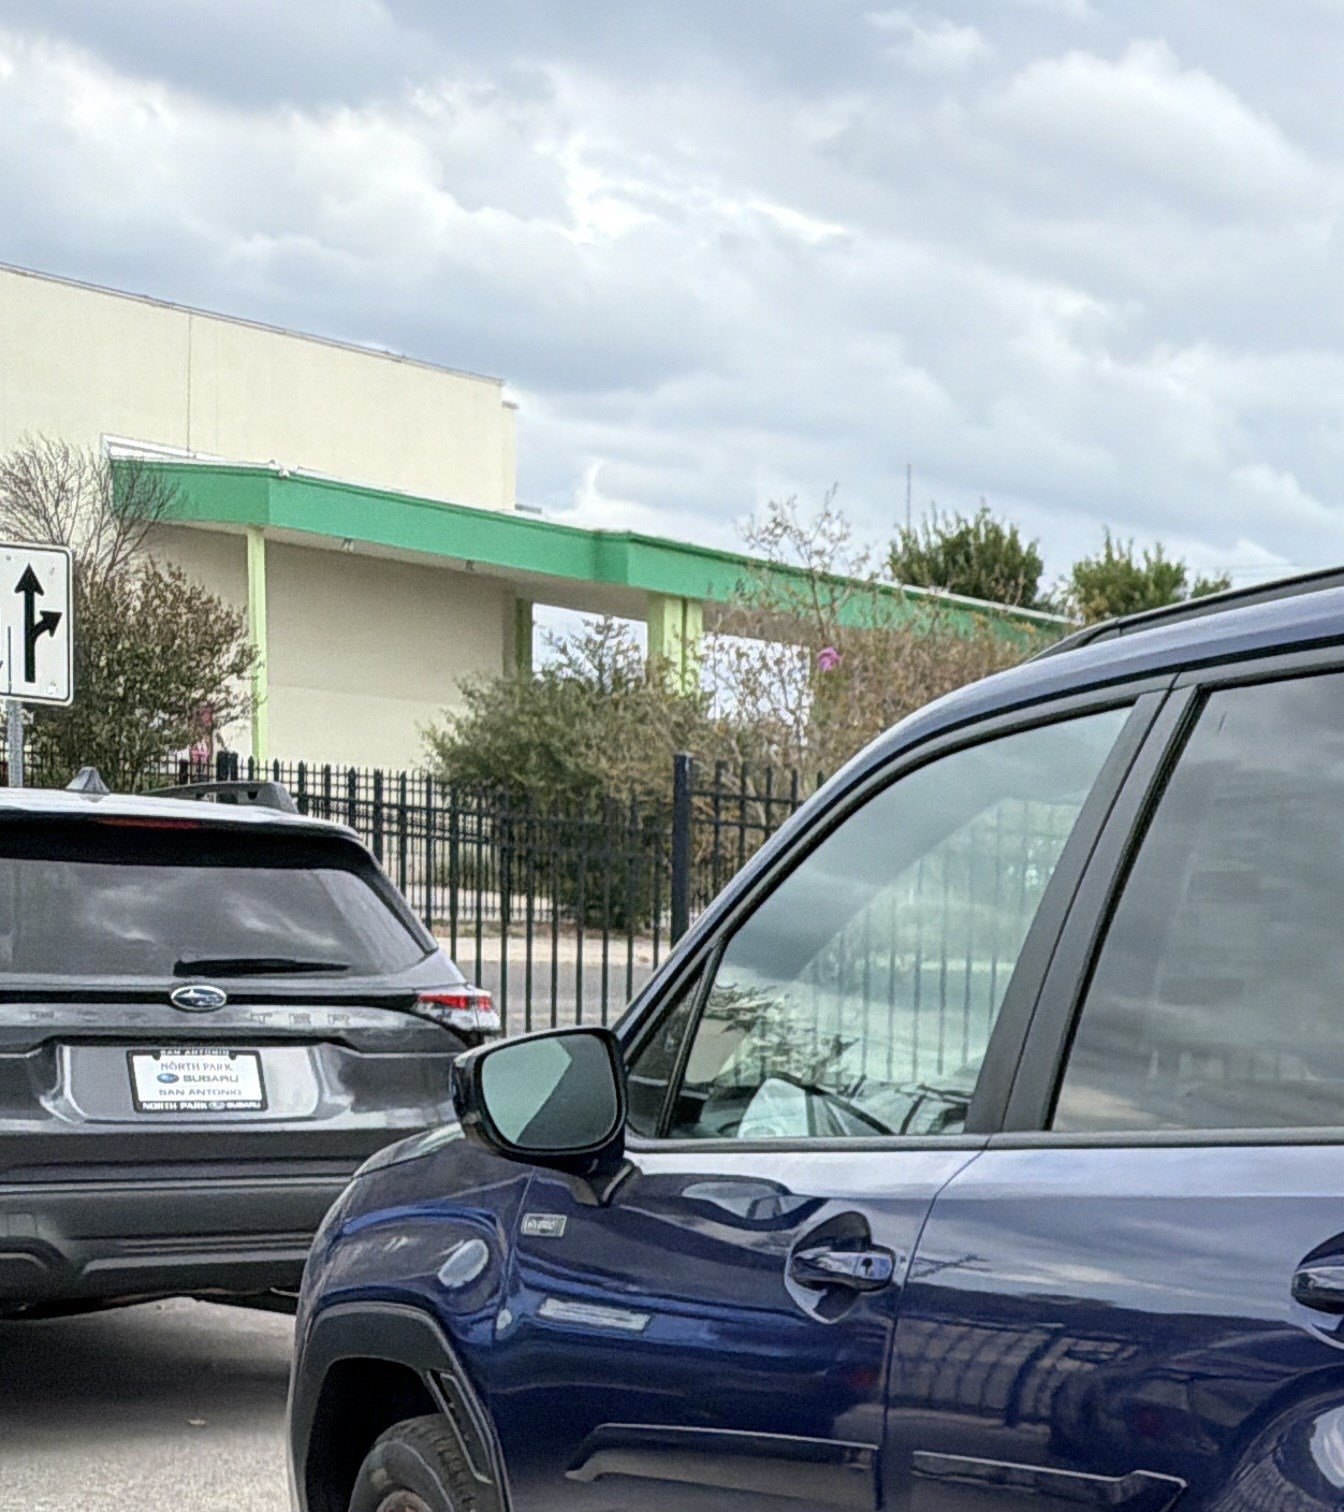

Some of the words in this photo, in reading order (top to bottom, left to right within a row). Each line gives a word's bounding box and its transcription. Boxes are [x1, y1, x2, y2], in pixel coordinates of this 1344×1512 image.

[160, 1061, 200, 1071] NORTH
[203, 1062, 233, 1071] PARK
[183, 1074, 239, 1083] SUBARU
[142, 1102, 177, 1110] NORTH
